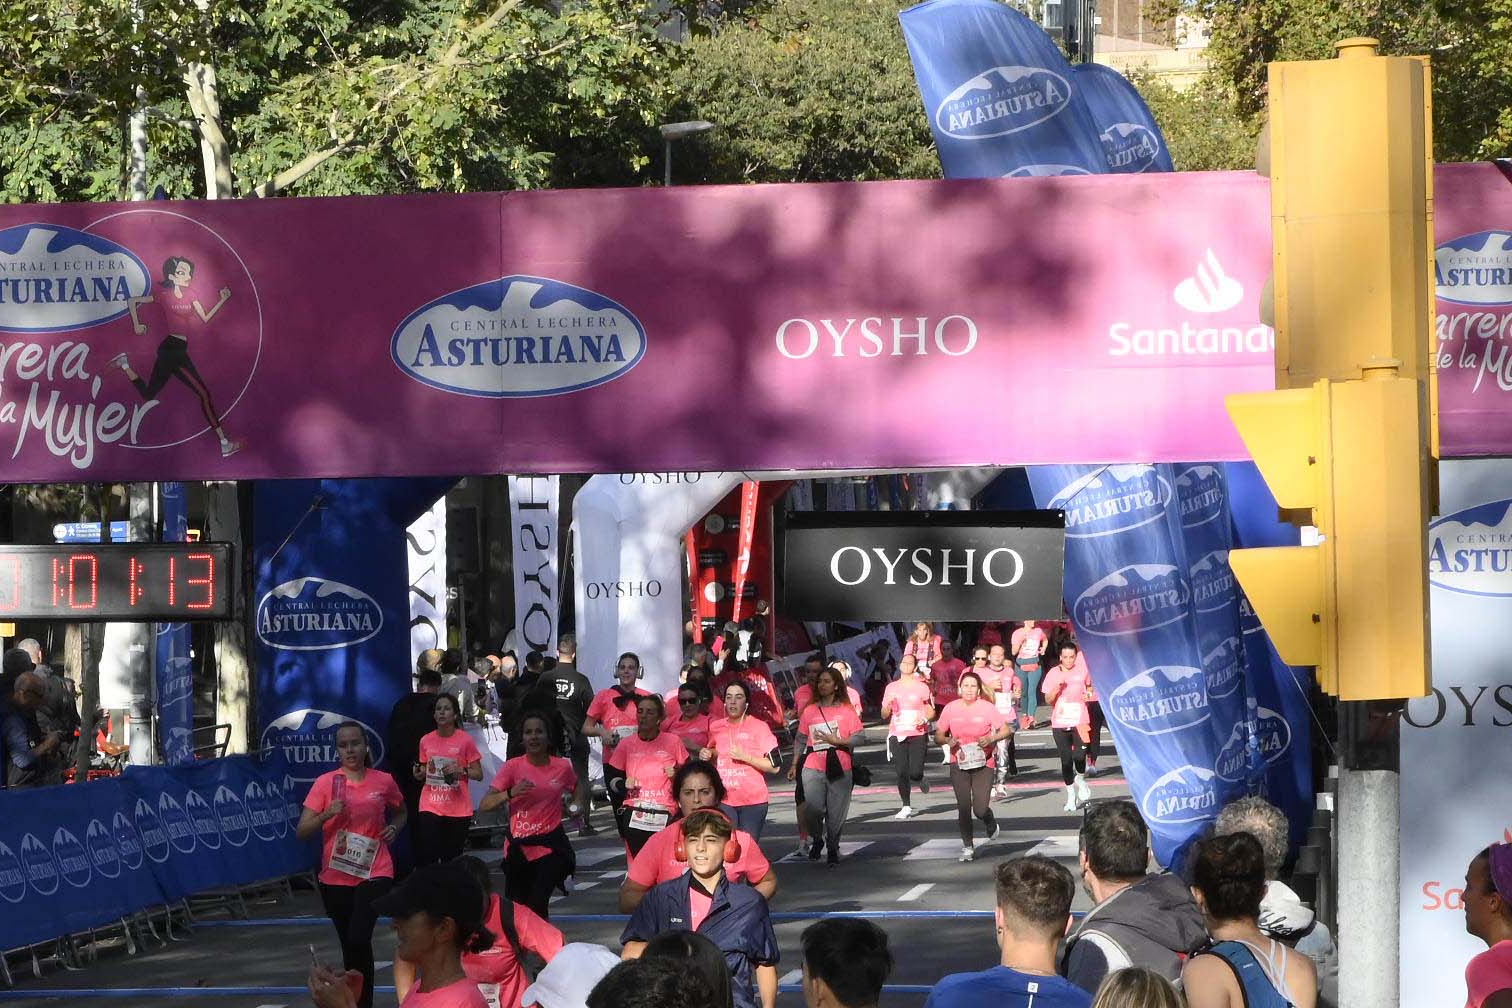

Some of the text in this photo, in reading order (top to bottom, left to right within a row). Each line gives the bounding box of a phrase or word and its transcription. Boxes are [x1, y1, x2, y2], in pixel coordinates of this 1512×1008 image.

[53, 260, 127, 271] LECHERA
[450, 316, 618, 331] CENTRAL LECHERA
[776, 314, 978, 359] OYSHO
[411, 323, 626, 367] ASTURIANA
[12, 370, 159, 469] Mujer
[830, 546, 1024, 587] OYSHO
[587, 579, 662, 601] OYSHO
[261, 608, 374, 635] ASTURIANA
